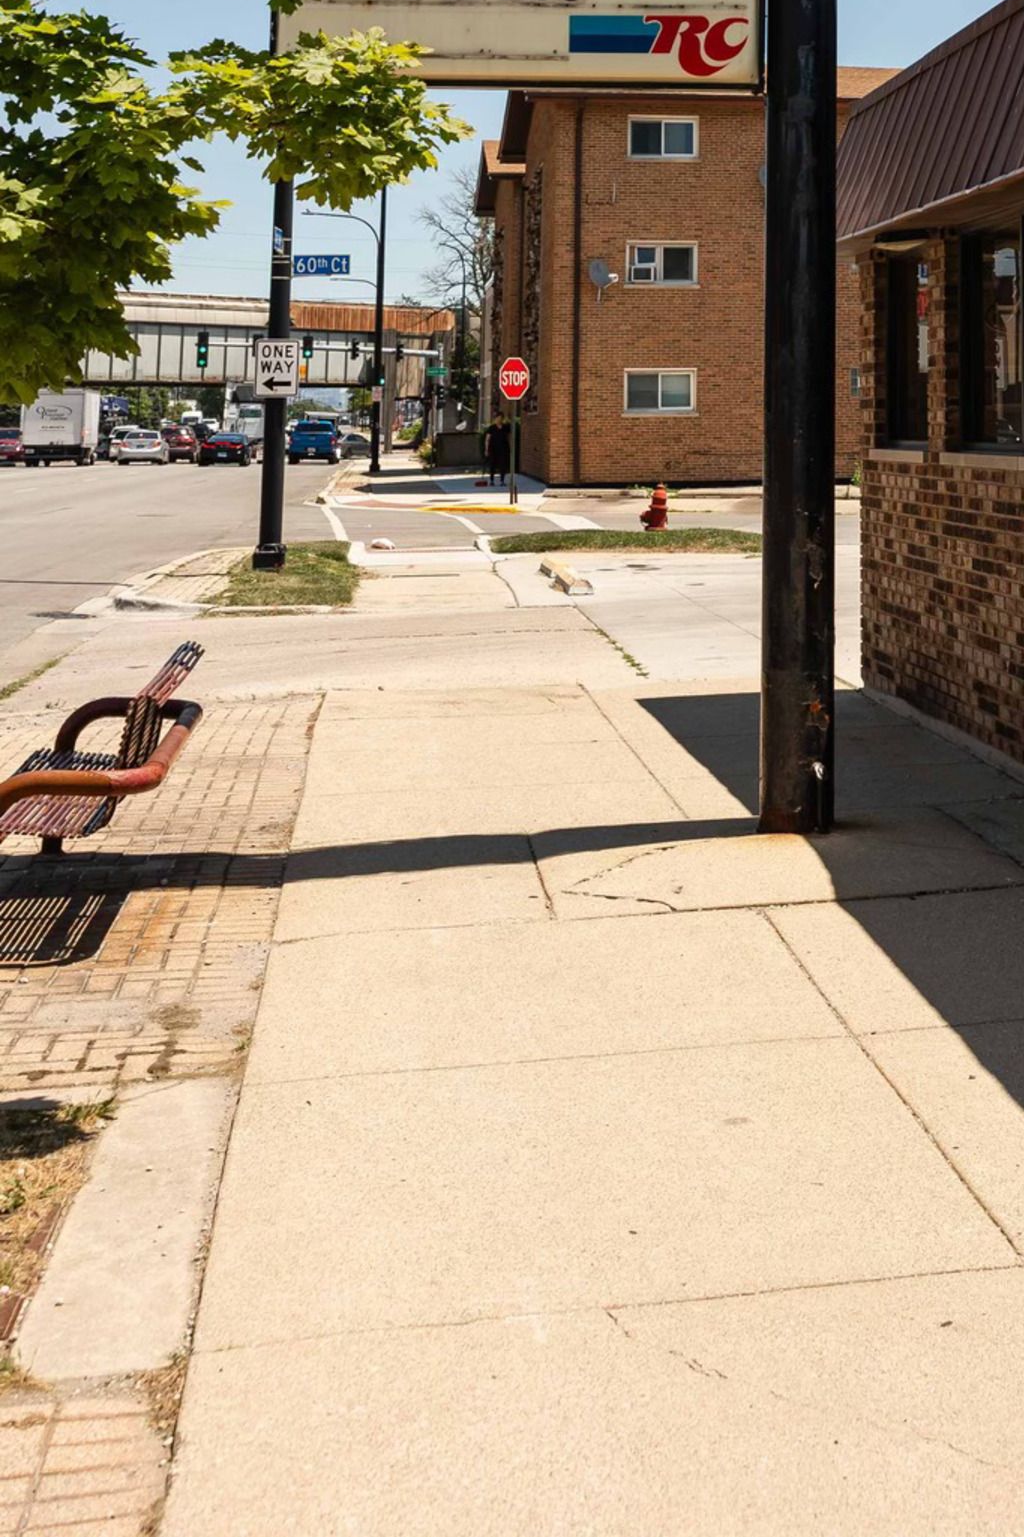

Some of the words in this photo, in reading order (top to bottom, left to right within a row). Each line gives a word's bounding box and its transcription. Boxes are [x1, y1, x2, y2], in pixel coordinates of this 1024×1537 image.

[644, 15, 750, 77] RC
[296, 257, 328, 273] 60th
[330, 257, 348, 273] Ct
[262, 344, 294, 358] ONE
[260, 360, 294, 374] WAY
[502, 370, 528, 386] STOP
